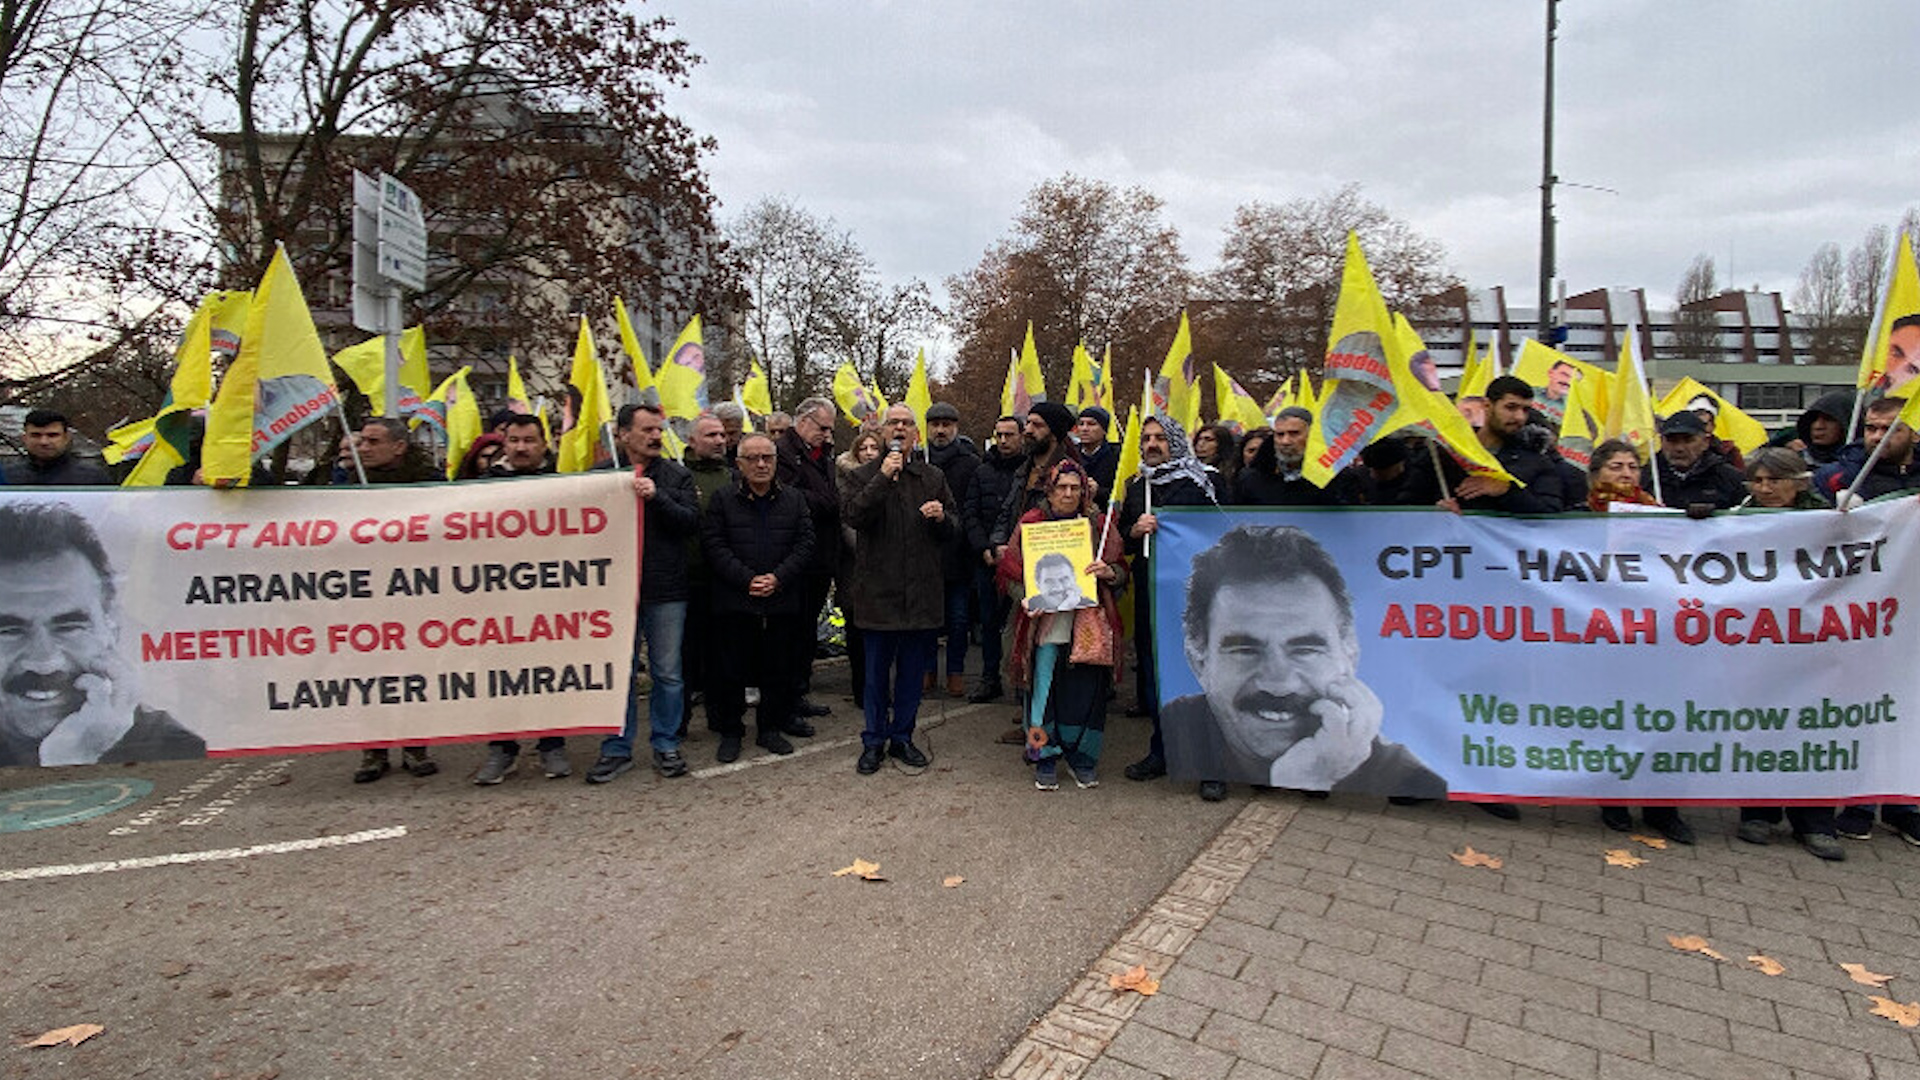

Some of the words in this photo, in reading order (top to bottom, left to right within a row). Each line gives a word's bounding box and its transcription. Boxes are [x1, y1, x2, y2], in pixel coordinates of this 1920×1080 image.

[166, 522, 249, 551] CPT
[253, 519, 338, 547] AND
[443, 507, 608, 542] SHOULD
[185, 569, 373, 605] ARRANGE
[386, 566, 440, 597] AN
[452, 558, 613, 594] URGENT
[1377, 545, 1473, 580] CPT
[1516, 548, 1649, 582] HAVE
[1659, 549, 1779, 586] YOU
[1795, 536, 1888, 581] MET
[141, 626, 316, 663] MEETING
[327, 622, 406, 654] FOR
[417, 609, 614, 649] OCALAN'S
[1379, 603, 1657, 645] ABDULLAH
[1674, 597, 1899, 646] ÖCALAN?
[267, 673, 428, 711] LAWYER
[438, 671, 476, 701] IN
[488, 662, 614, 697] IMRALI
[1459, 694, 1519, 726] We
[1528, 700, 1624, 731] need
[1633, 703, 1677, 732] to
[1685, 699, 1790, 732] know
[1797, 693, 1898, 730] about
[1462, 734, 1517, 768] his
[1525, 740, 1645, 780] safety
[1651, 741, 1723, 773] and
[1731, 740, 1860, 773] health!
